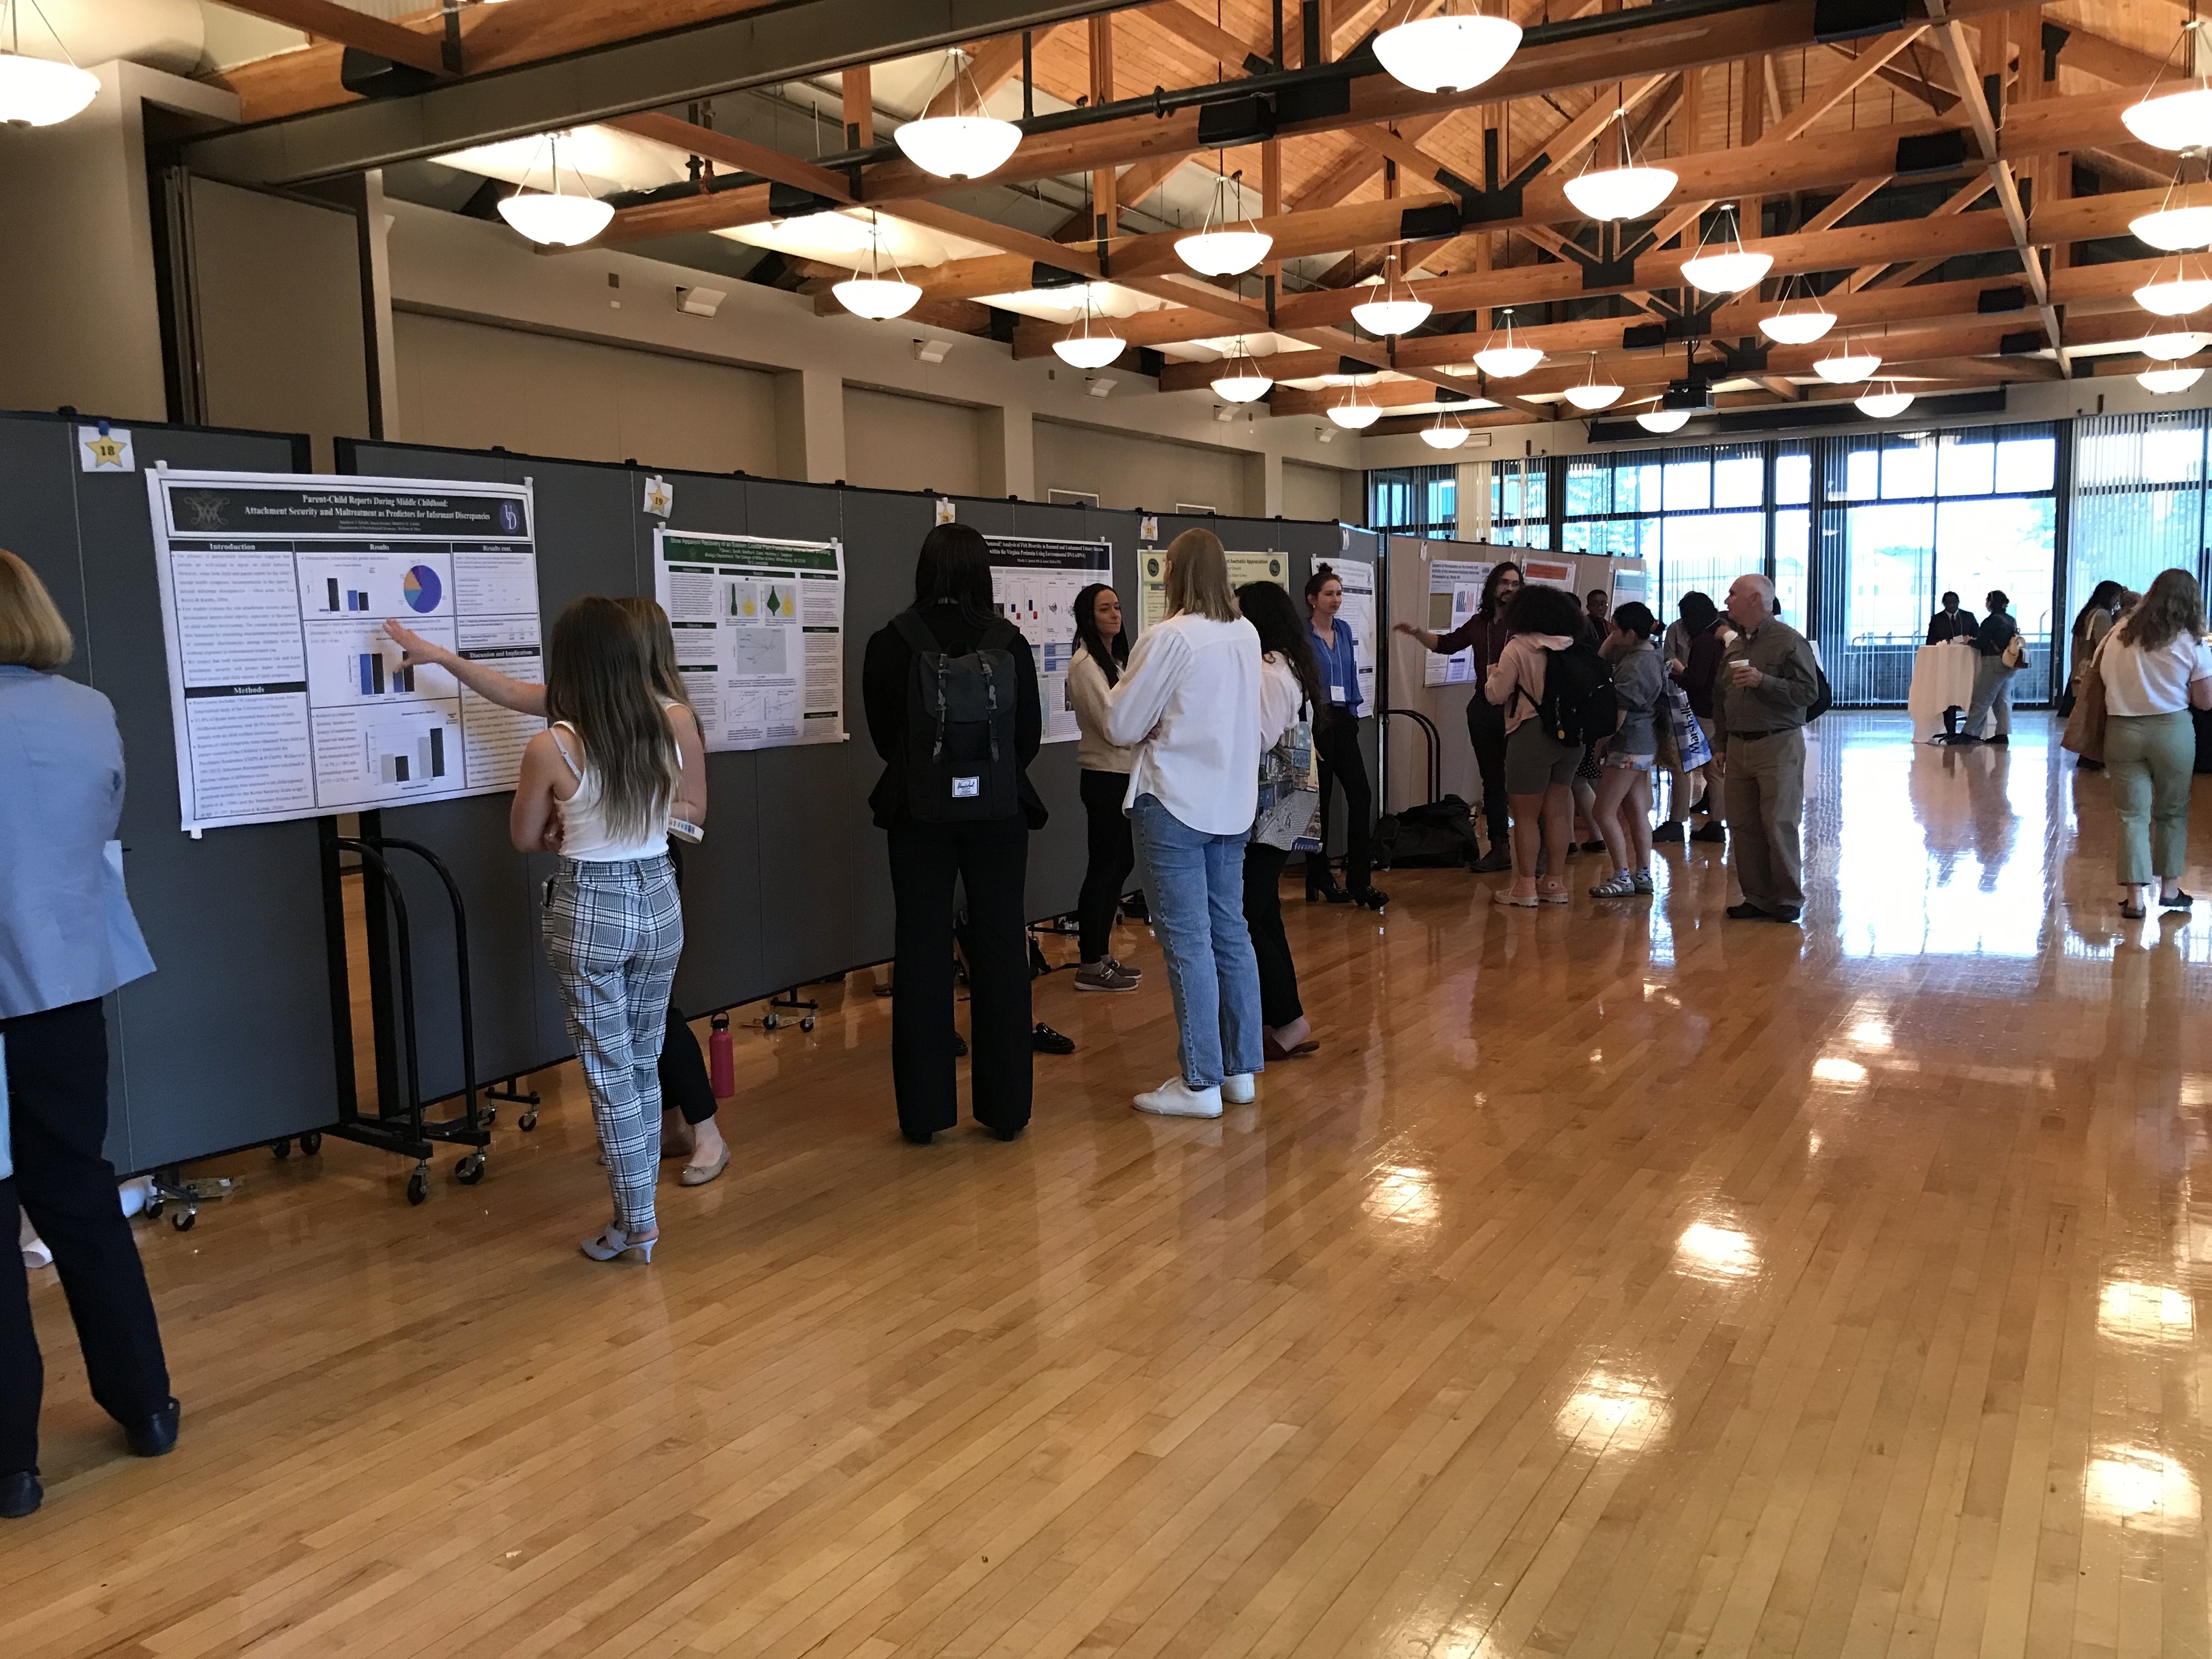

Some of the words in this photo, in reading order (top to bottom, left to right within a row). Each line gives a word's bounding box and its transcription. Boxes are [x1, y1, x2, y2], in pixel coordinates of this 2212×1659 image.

[100, 445, 115, 456] 18
[303, 495, 347, 504] Parent-Child
[349, 496, 373, 505] Reports
[374, 497, 395, 506] During
[396, 498, 416, 506] Middle
[417, 498, 448, 507] Childhood:
[655, 497, 663, 505] 19
[245, 506, 287, 515] Attachment
[289, 506, 318, 517] Security
[320, 507, 333, 516] and
[335, 507, 377, 516] Maltreatment
[386, 509, 415, 517] Predictors
[427, 510, 454, 518] Informant
[455, 511, 490, 521] Discrepancies
[1680, 702, 1700, 754] Marshalls
